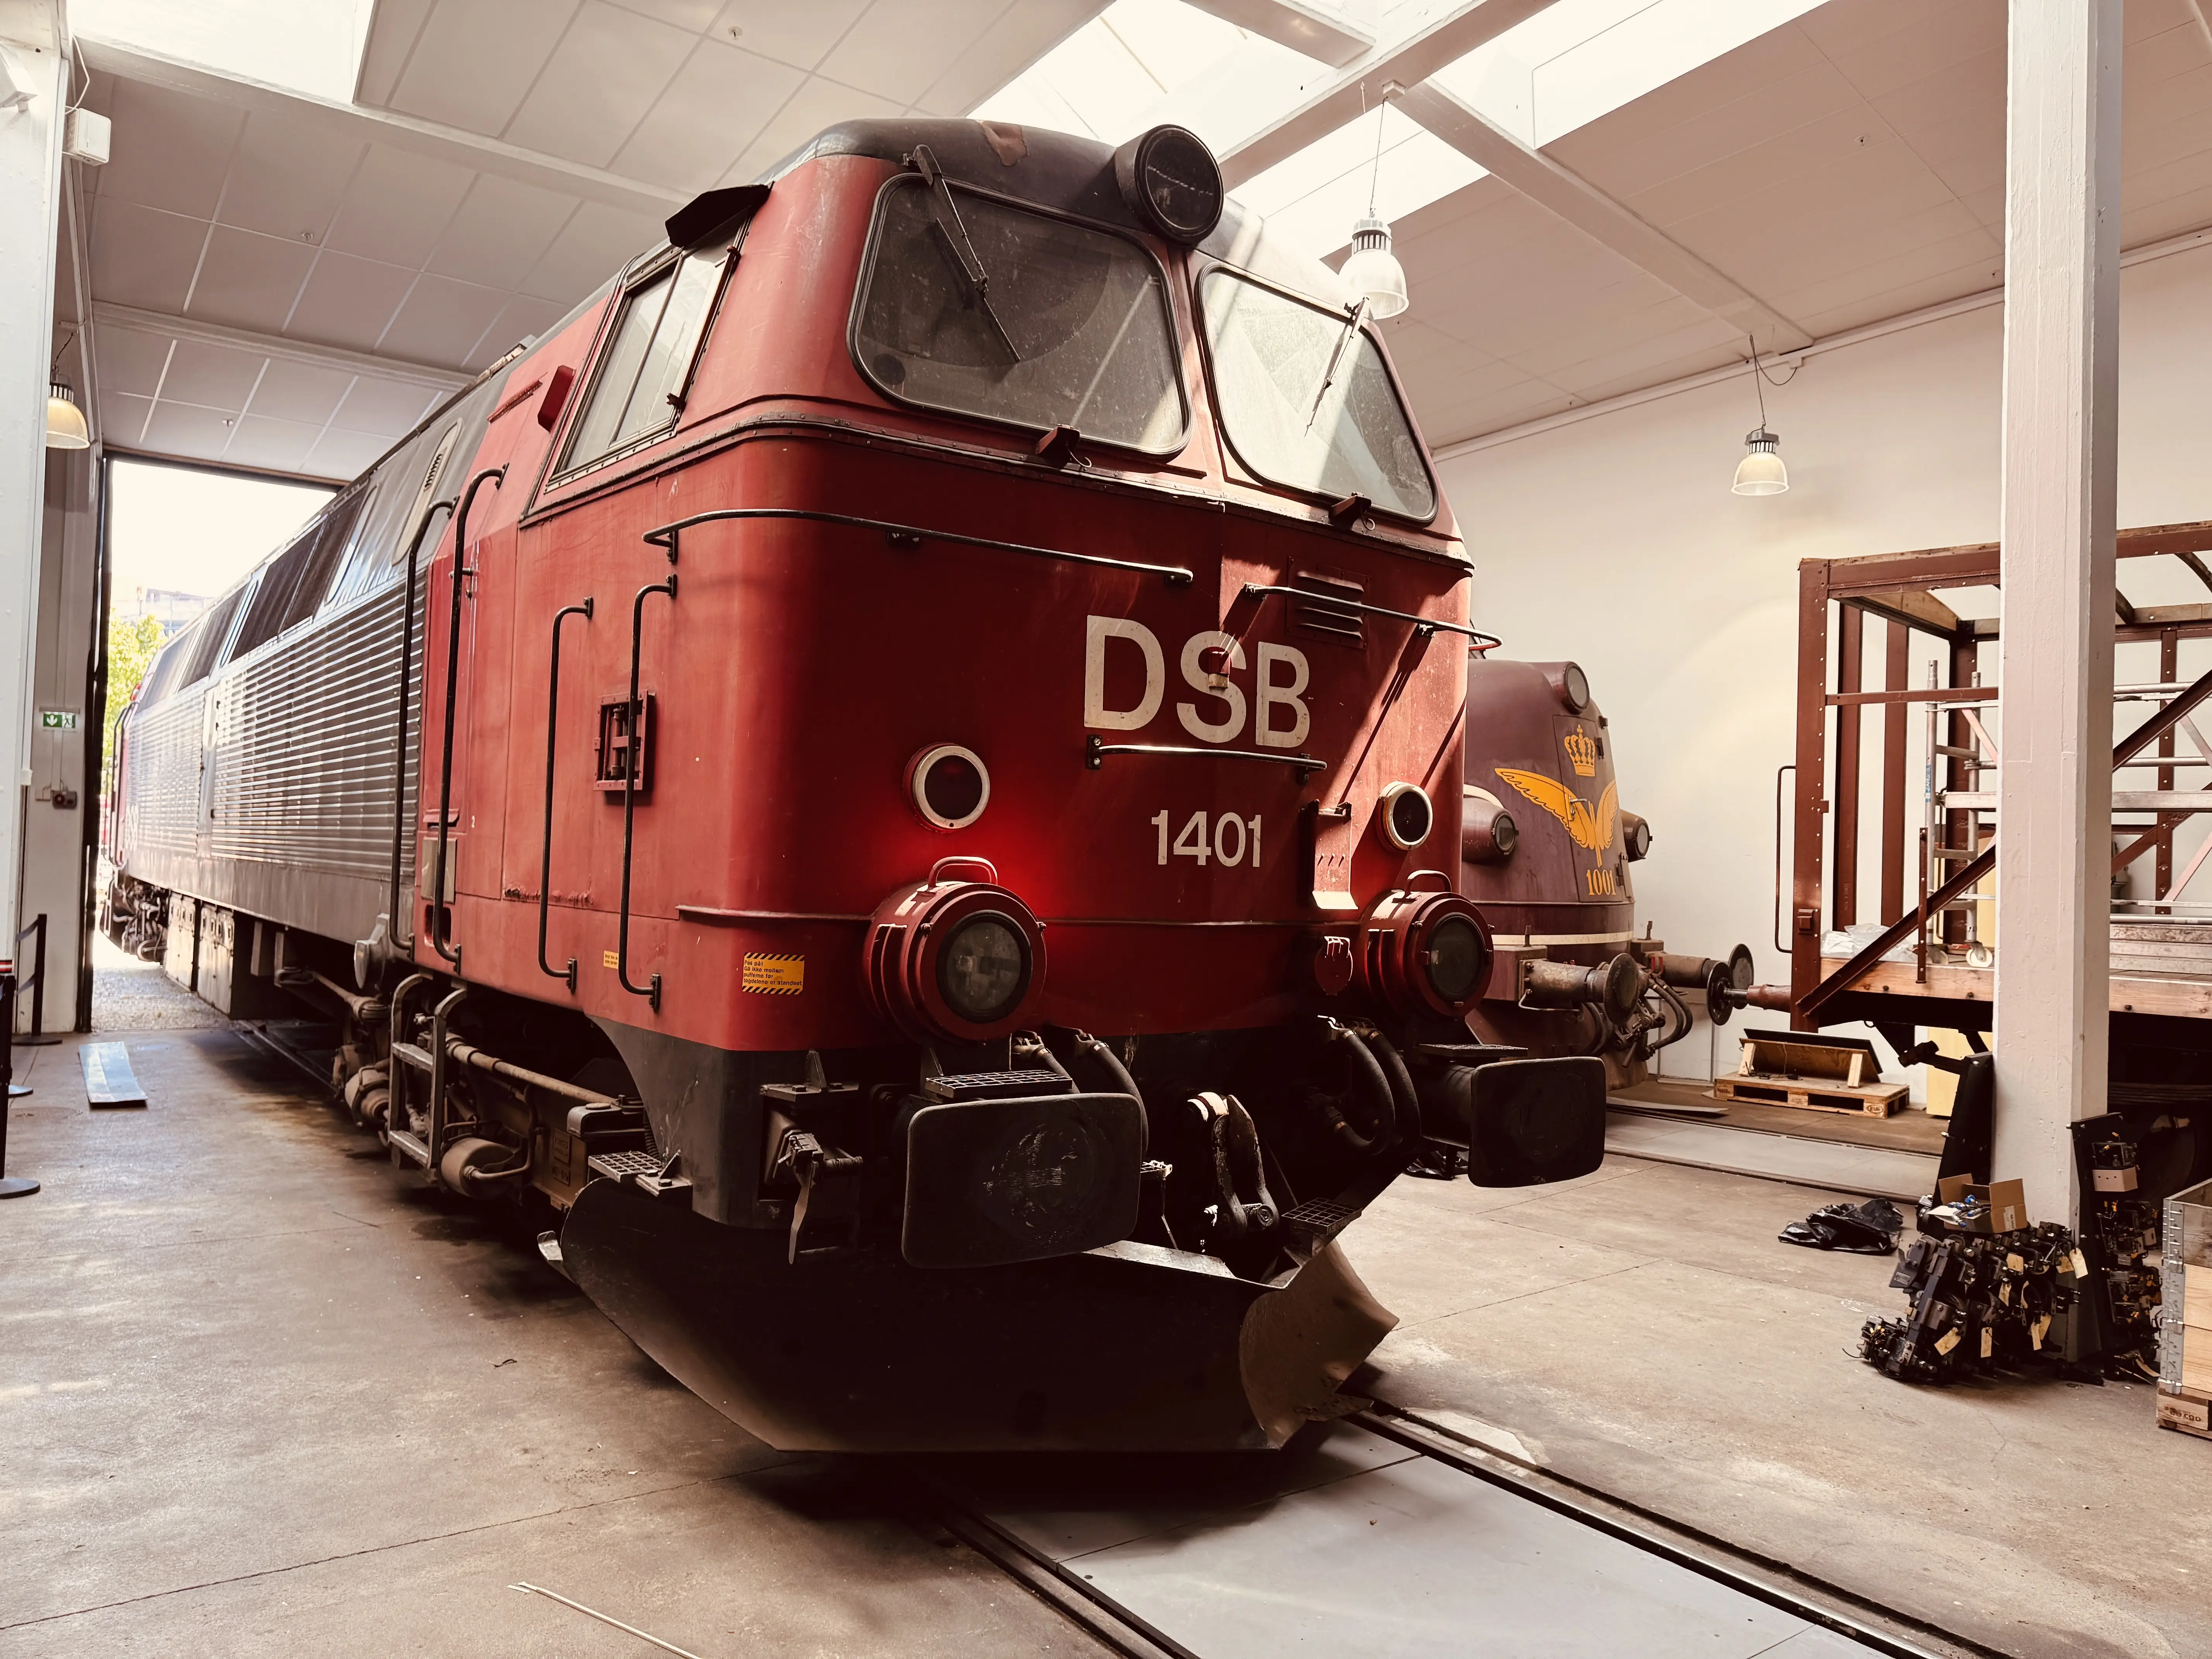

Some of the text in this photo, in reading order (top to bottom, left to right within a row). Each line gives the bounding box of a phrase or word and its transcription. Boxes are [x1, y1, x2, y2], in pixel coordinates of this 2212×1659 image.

[1084, 615, 1310, 748] DSB
[472, 815, 475, 828] 2
[1151, 810, 1261, 867] 1401
[1586, 869, 1616, 895] 1001
